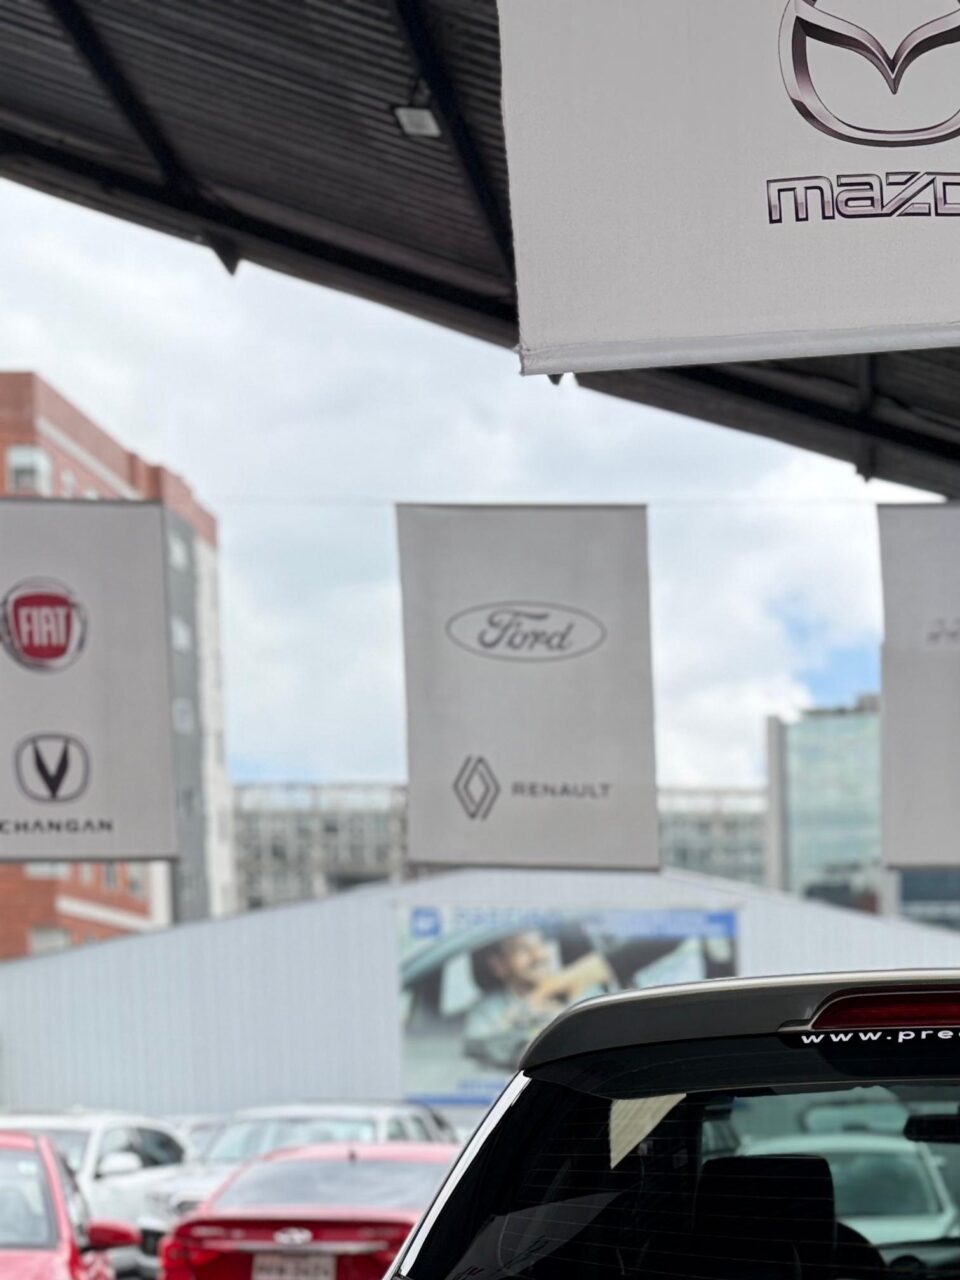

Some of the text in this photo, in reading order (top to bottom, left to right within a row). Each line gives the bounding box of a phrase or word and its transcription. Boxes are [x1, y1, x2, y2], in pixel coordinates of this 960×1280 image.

[18, 605, 71, 647] FIAT
[477, 609, 575, 651] Ford
[511, 781, 611, 799] RENAULT
[0, 819, 114, 835] CHANGAN
